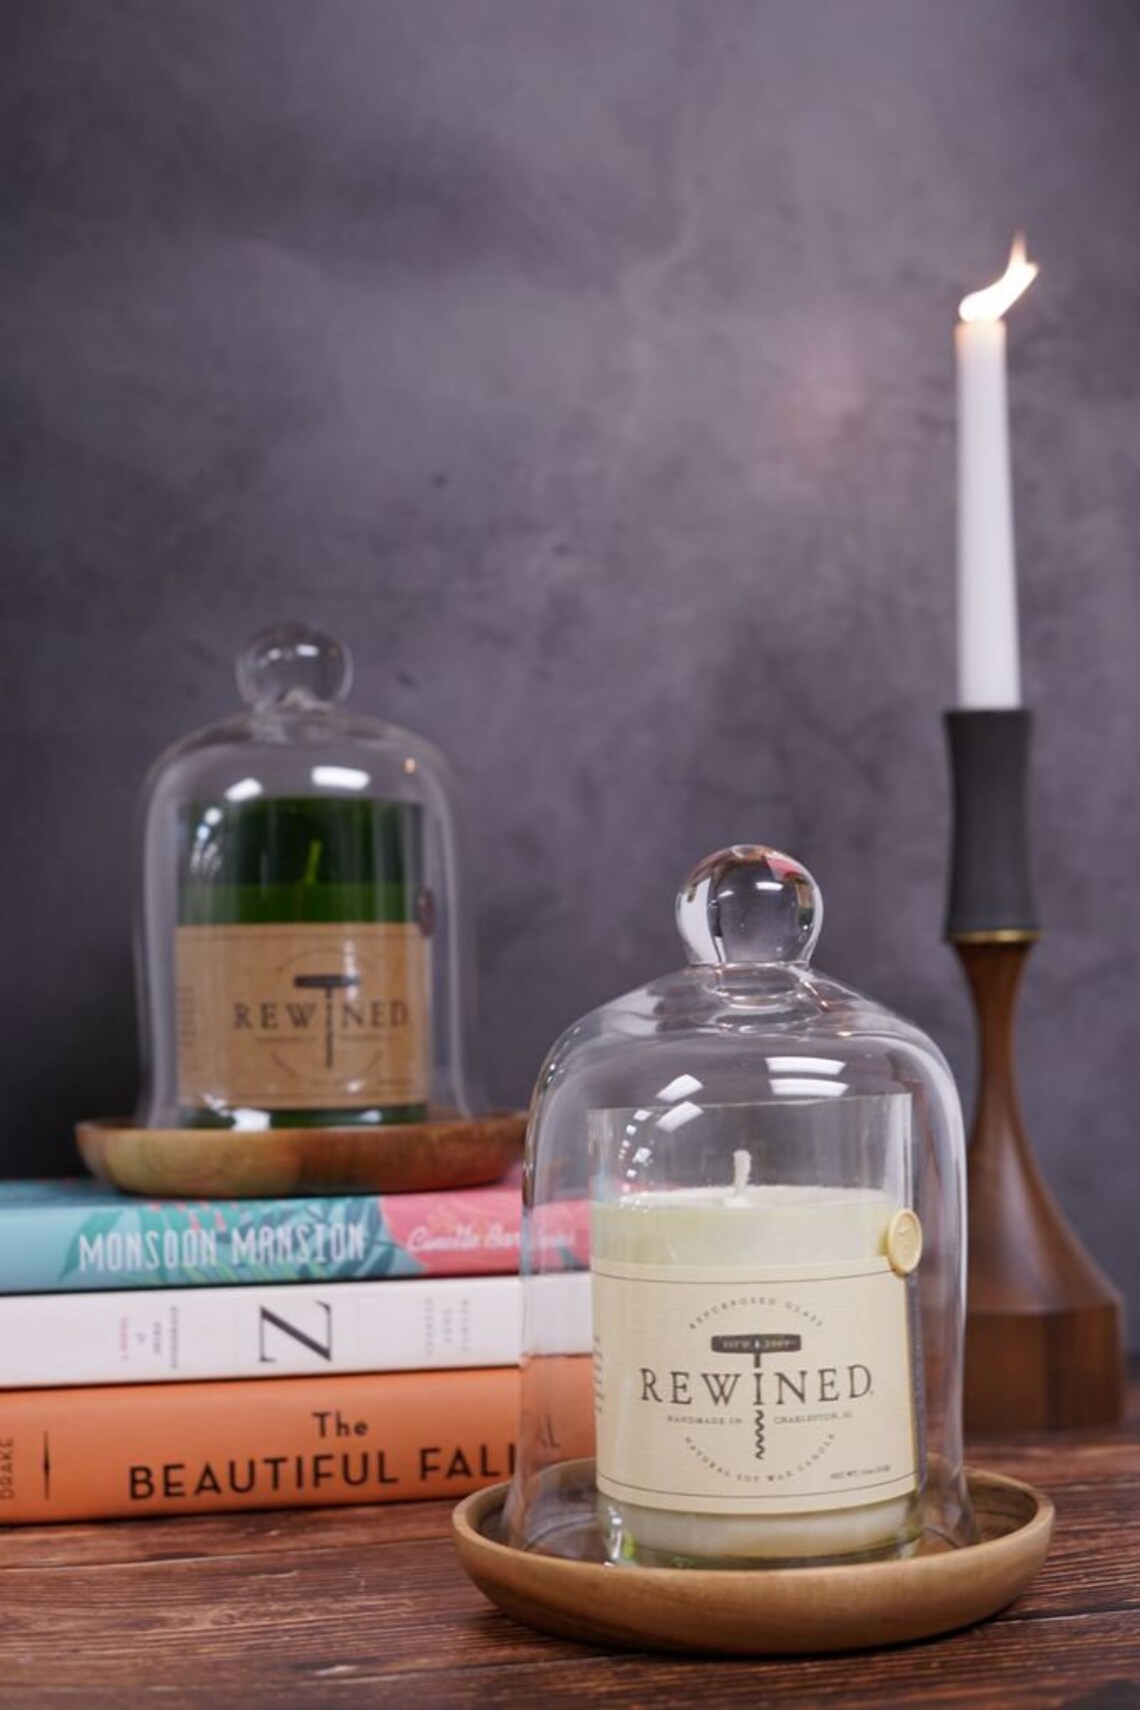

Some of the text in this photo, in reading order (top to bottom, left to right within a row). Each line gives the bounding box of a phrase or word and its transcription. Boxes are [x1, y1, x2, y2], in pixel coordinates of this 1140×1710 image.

[79, 1220, 365, 1272] MONSOON MANSION
[639, 1364, 873, 1406] REWINED
[312, 1411, 369, 1439] The
[129, 1451, 398, 1501] BEAUTIFUL
